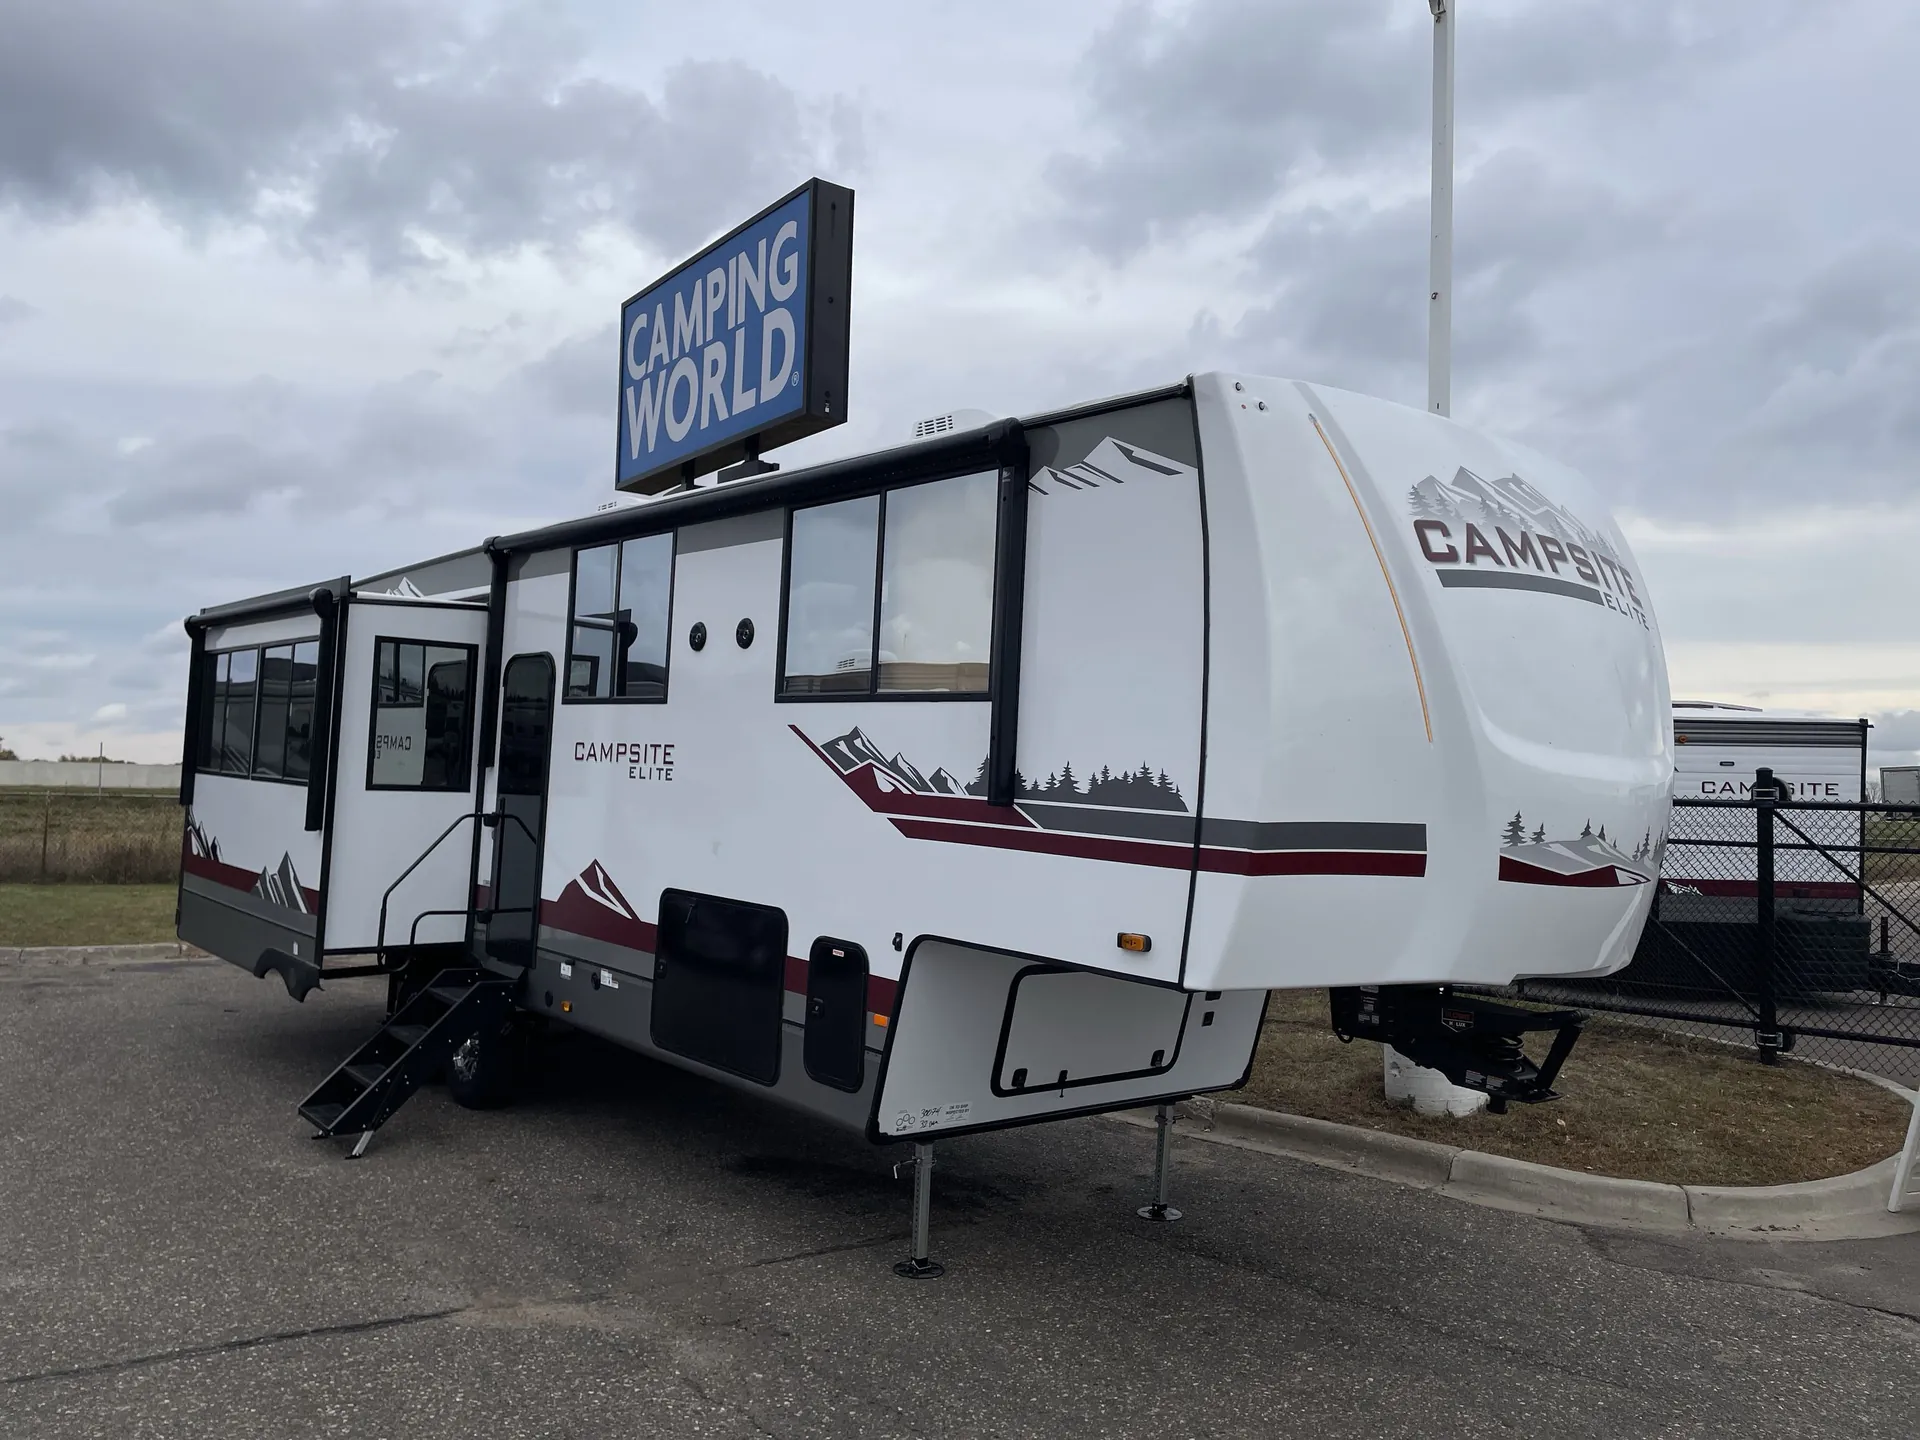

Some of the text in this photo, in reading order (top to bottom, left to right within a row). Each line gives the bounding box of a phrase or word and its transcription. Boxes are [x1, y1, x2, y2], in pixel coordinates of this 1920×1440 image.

[626, 220, 798, 381] CAMPING
[626, 307, 796, 460] WORLD
[1413, 519, 1643, 609] CAMPSITE
[1602, 591, 1650, 631] ELITE
[574, 742, 675, 765] CAMPSITE
[629, 766, 673, 781] ELITE
[1701, 781, 1838, 796] CAMSITE
